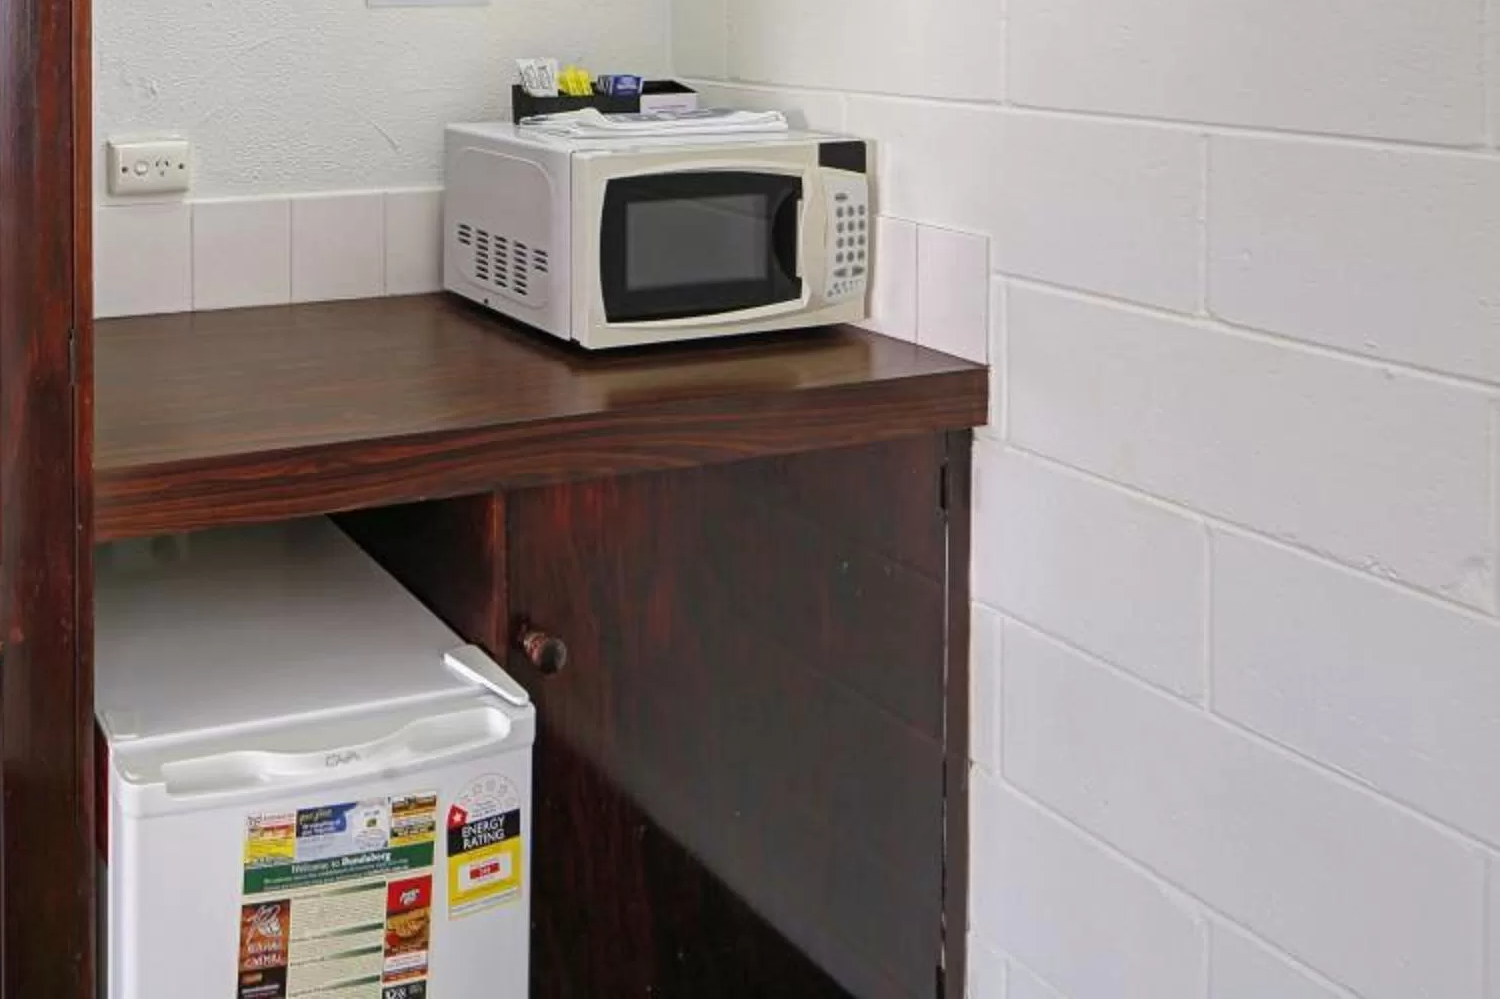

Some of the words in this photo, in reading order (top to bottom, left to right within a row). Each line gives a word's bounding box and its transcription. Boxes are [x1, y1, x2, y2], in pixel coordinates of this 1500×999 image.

[461, 813, 506, 839] ENERGY
[463, 828, 506, 851] RATING
[341, 851, 392, 867] Bundaberg
